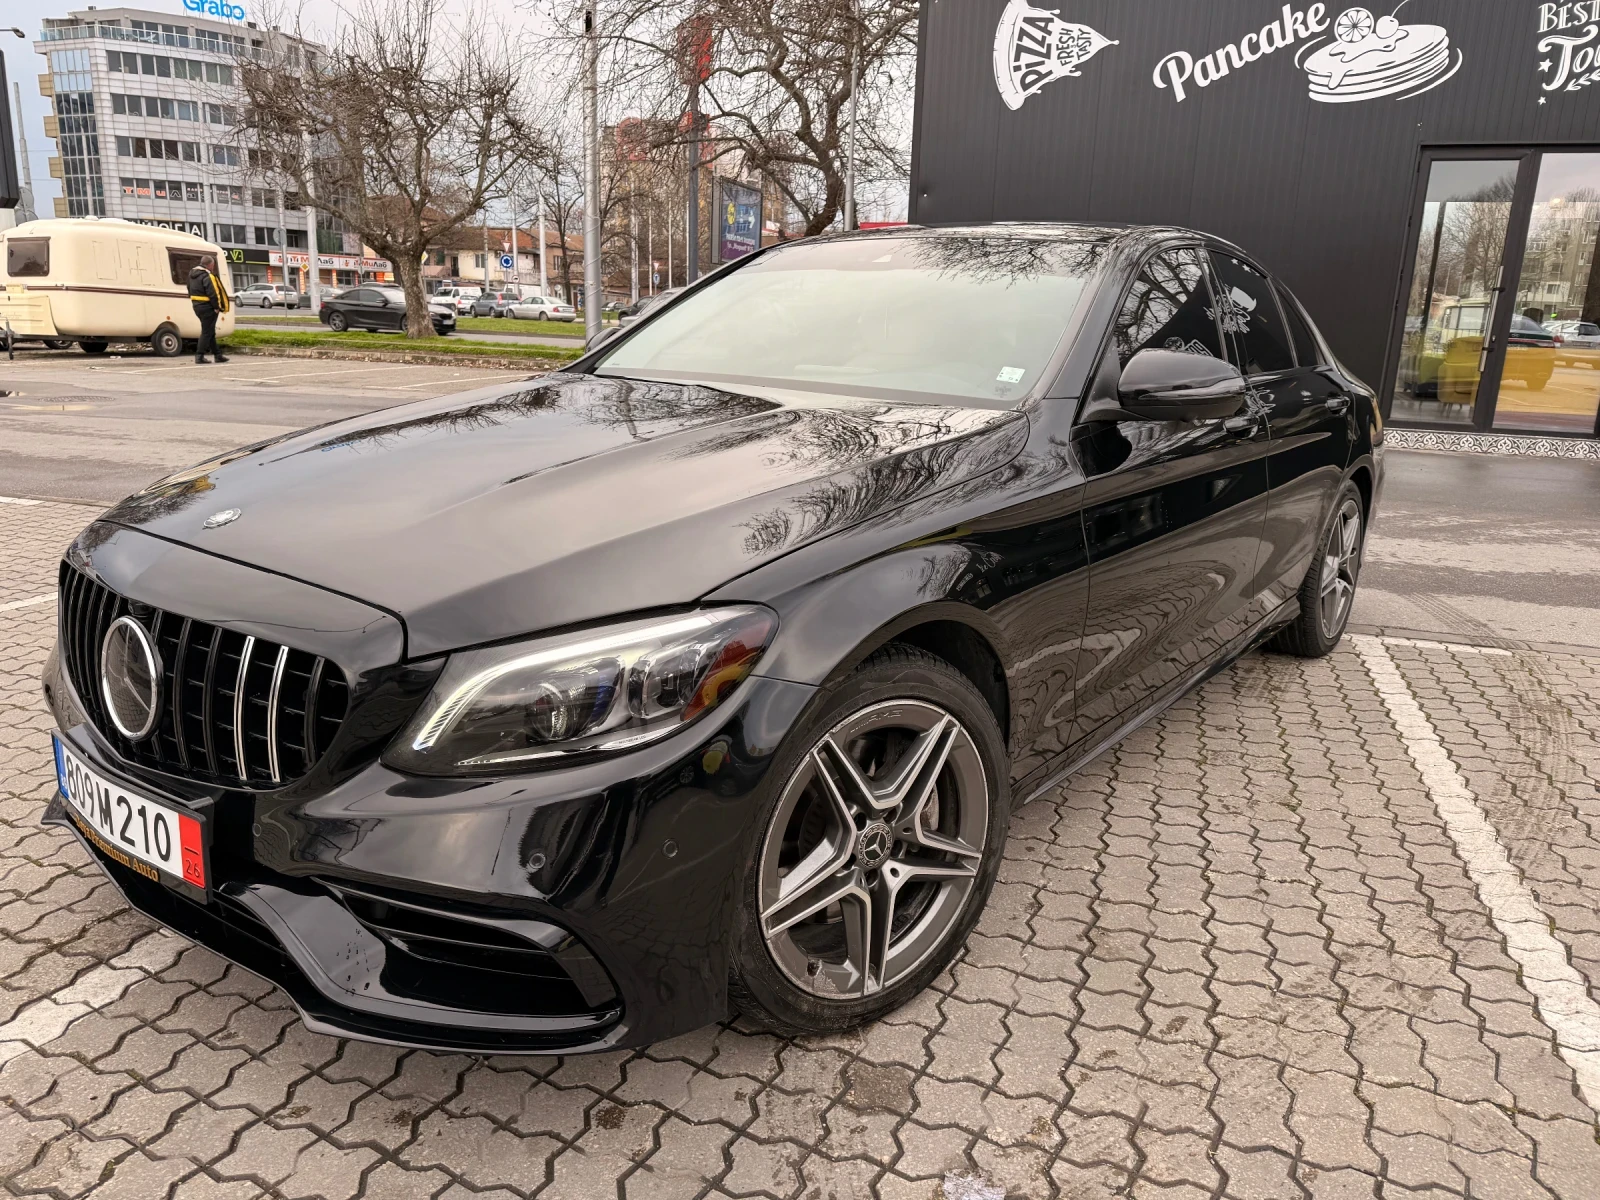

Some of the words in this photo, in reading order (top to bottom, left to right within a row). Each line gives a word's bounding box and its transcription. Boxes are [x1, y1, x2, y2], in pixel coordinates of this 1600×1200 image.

[183, 0, 244, 20] Grabo
[1056, 28, 1075, 66] FRESH
[1076, 28, 1092, 60] TASTY
[1152, 2, 1331, 103] Pancake
[90, 828, 131, 868] Premium
[132, 858, 159, 882] Auto
[185, 858, 201, 879] 26
